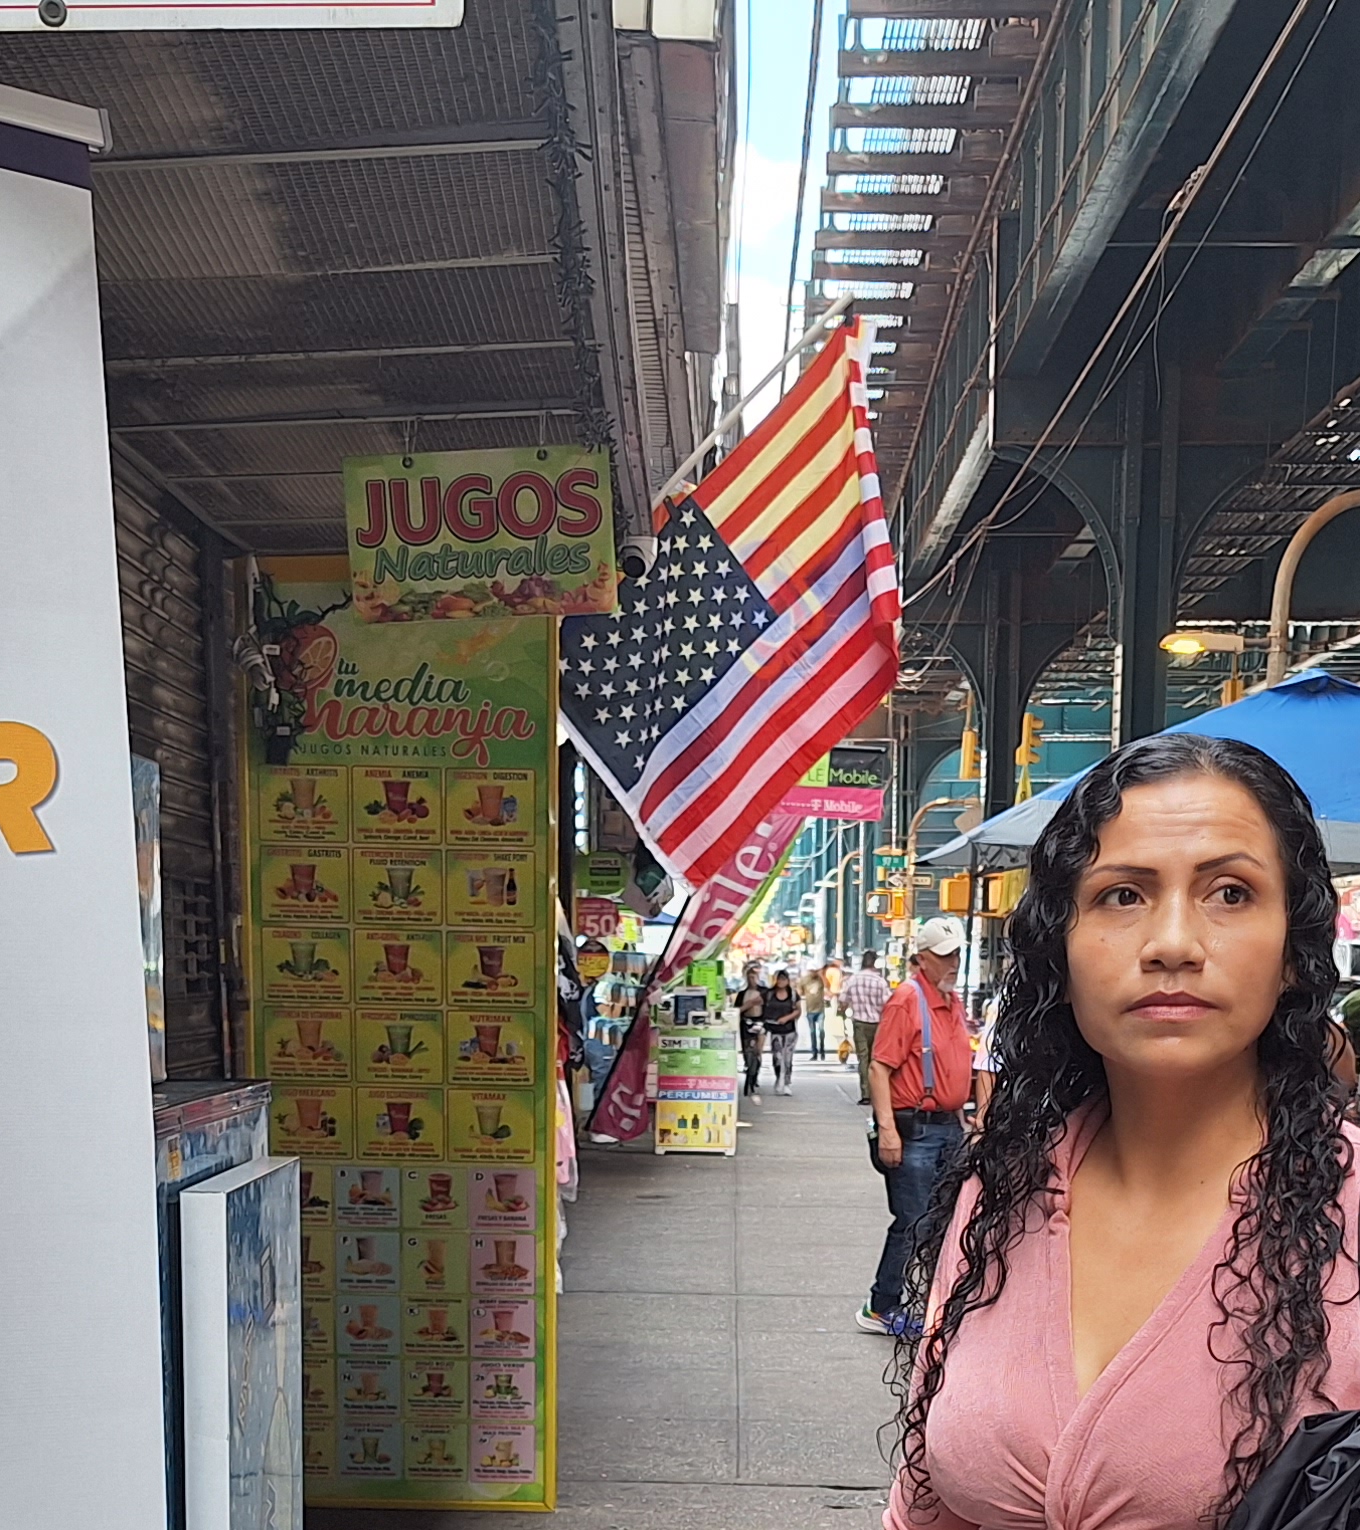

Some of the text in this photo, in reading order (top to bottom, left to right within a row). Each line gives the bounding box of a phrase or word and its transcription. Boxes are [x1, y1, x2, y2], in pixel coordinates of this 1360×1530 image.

[356, 468, 603, 548] JUGOS
[374, 535, 591, 583] Naturales
[334, 662, 470, 706] media
[361, 745, 446, 757] NATURALES
[829, 768, 878, 785] Mobile
[659, 1090, 728, 1100] PERFUMES
